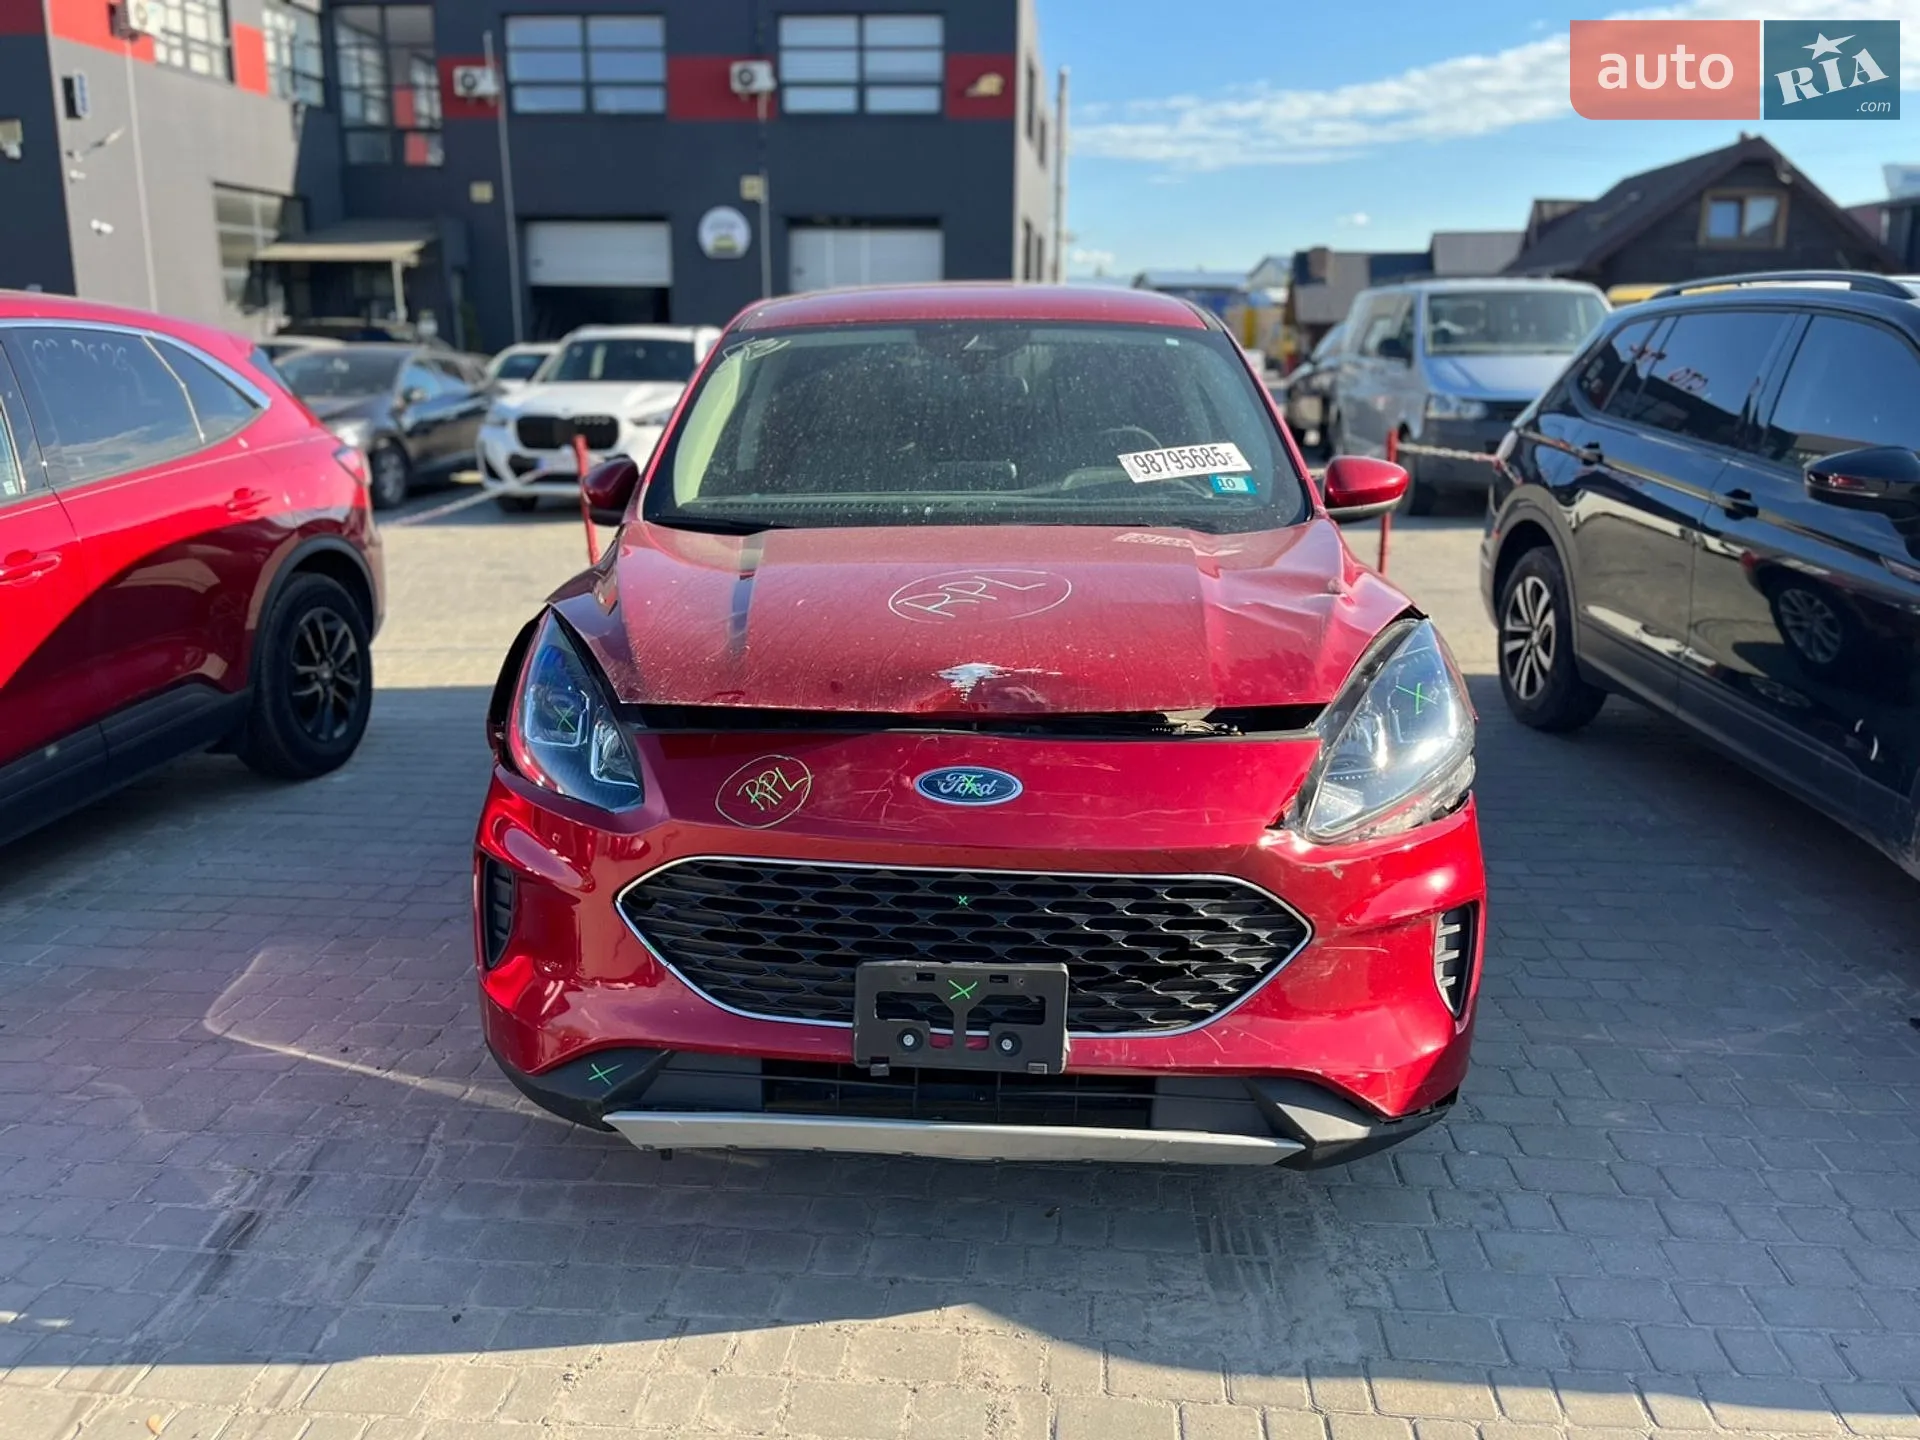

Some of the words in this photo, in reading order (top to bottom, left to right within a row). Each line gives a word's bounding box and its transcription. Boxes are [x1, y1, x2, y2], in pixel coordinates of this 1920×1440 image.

[1133, 446, 1229, 475] 98795685
[1217, 478, 1236, 489] 10
[939, 772, 998, 796] Ford
